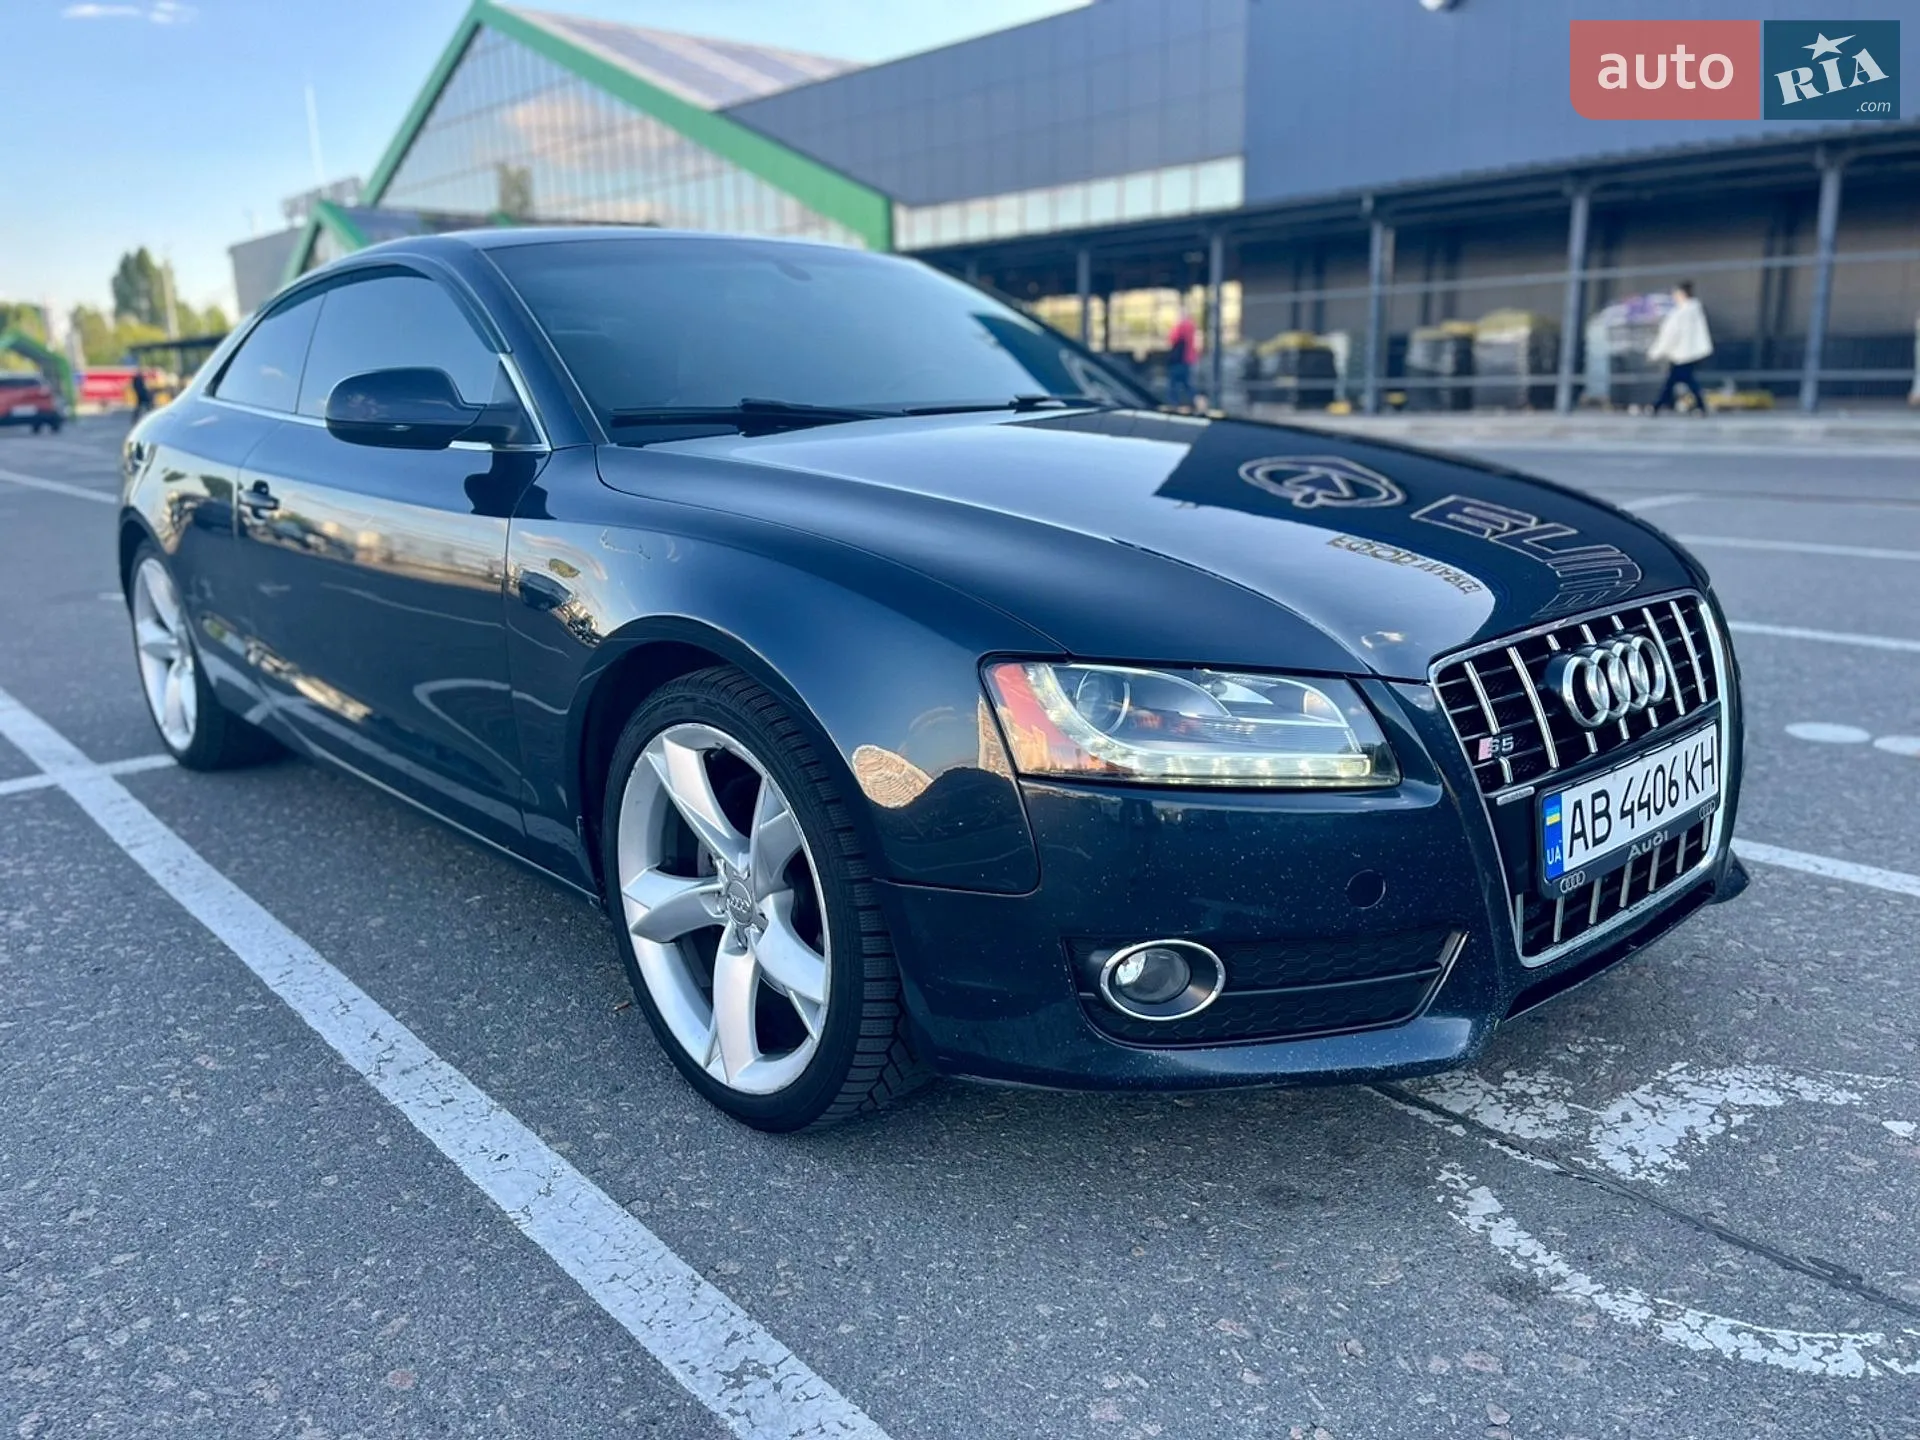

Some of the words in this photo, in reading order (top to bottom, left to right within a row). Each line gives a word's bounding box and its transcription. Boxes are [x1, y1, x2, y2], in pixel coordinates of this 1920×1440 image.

[1567, 788, 1613, 859] AB
[1619, 753, 1680, 830] 4406
[1684, 738, 1717, 801] KH
[1546, 847, 1562, 865] UA
[1627, 830, 1669, 862] Audi
